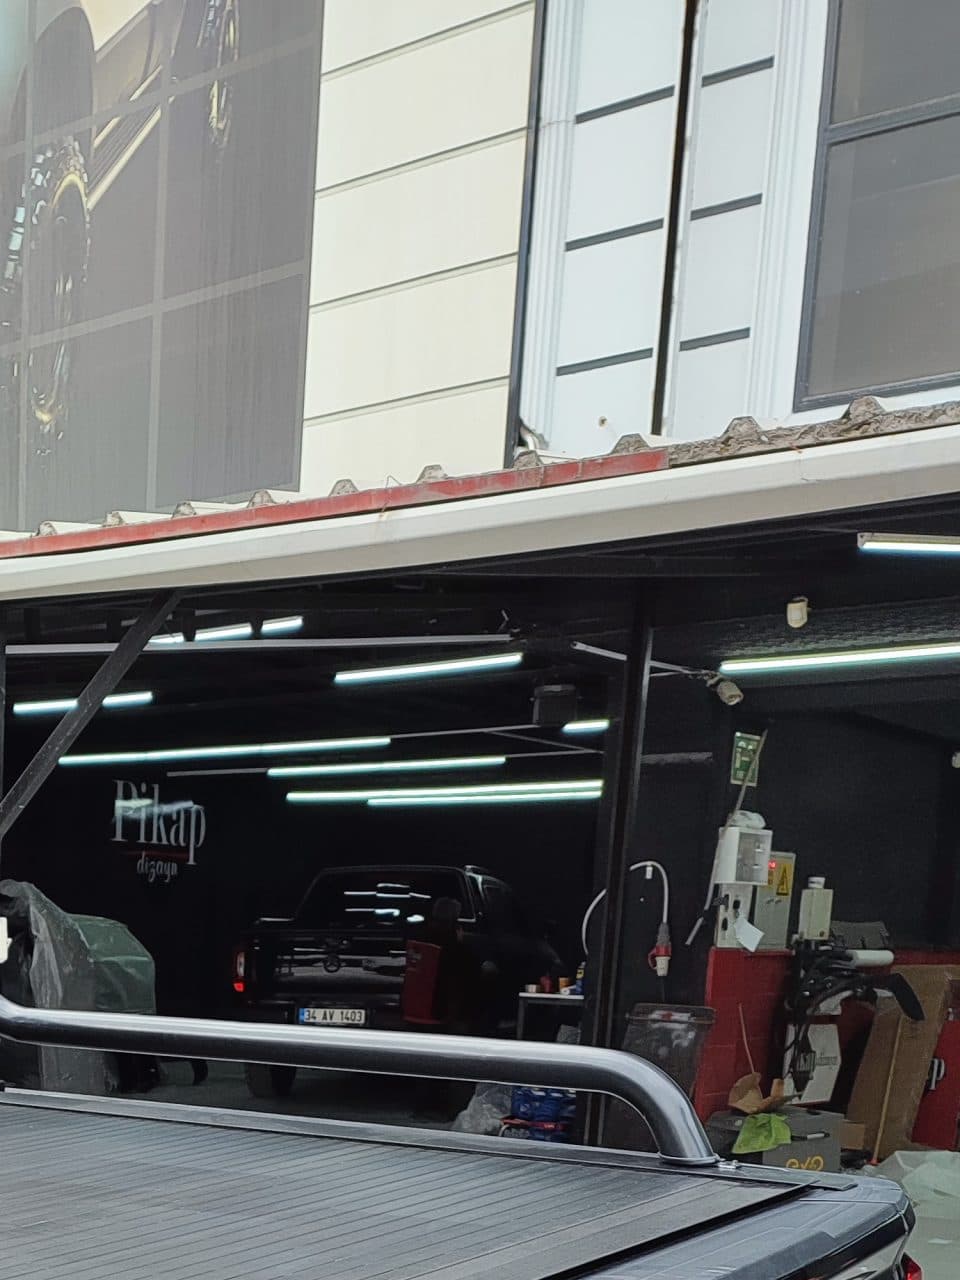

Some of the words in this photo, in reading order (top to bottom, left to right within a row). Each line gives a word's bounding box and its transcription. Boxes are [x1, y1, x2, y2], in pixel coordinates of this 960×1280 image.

[112, 780, 207, 866] Pikap
[136, 851, 179, 883] dizayn
[304, 1009, 317, 1021] 34
[340, 1009, 363, 1023] 1403
